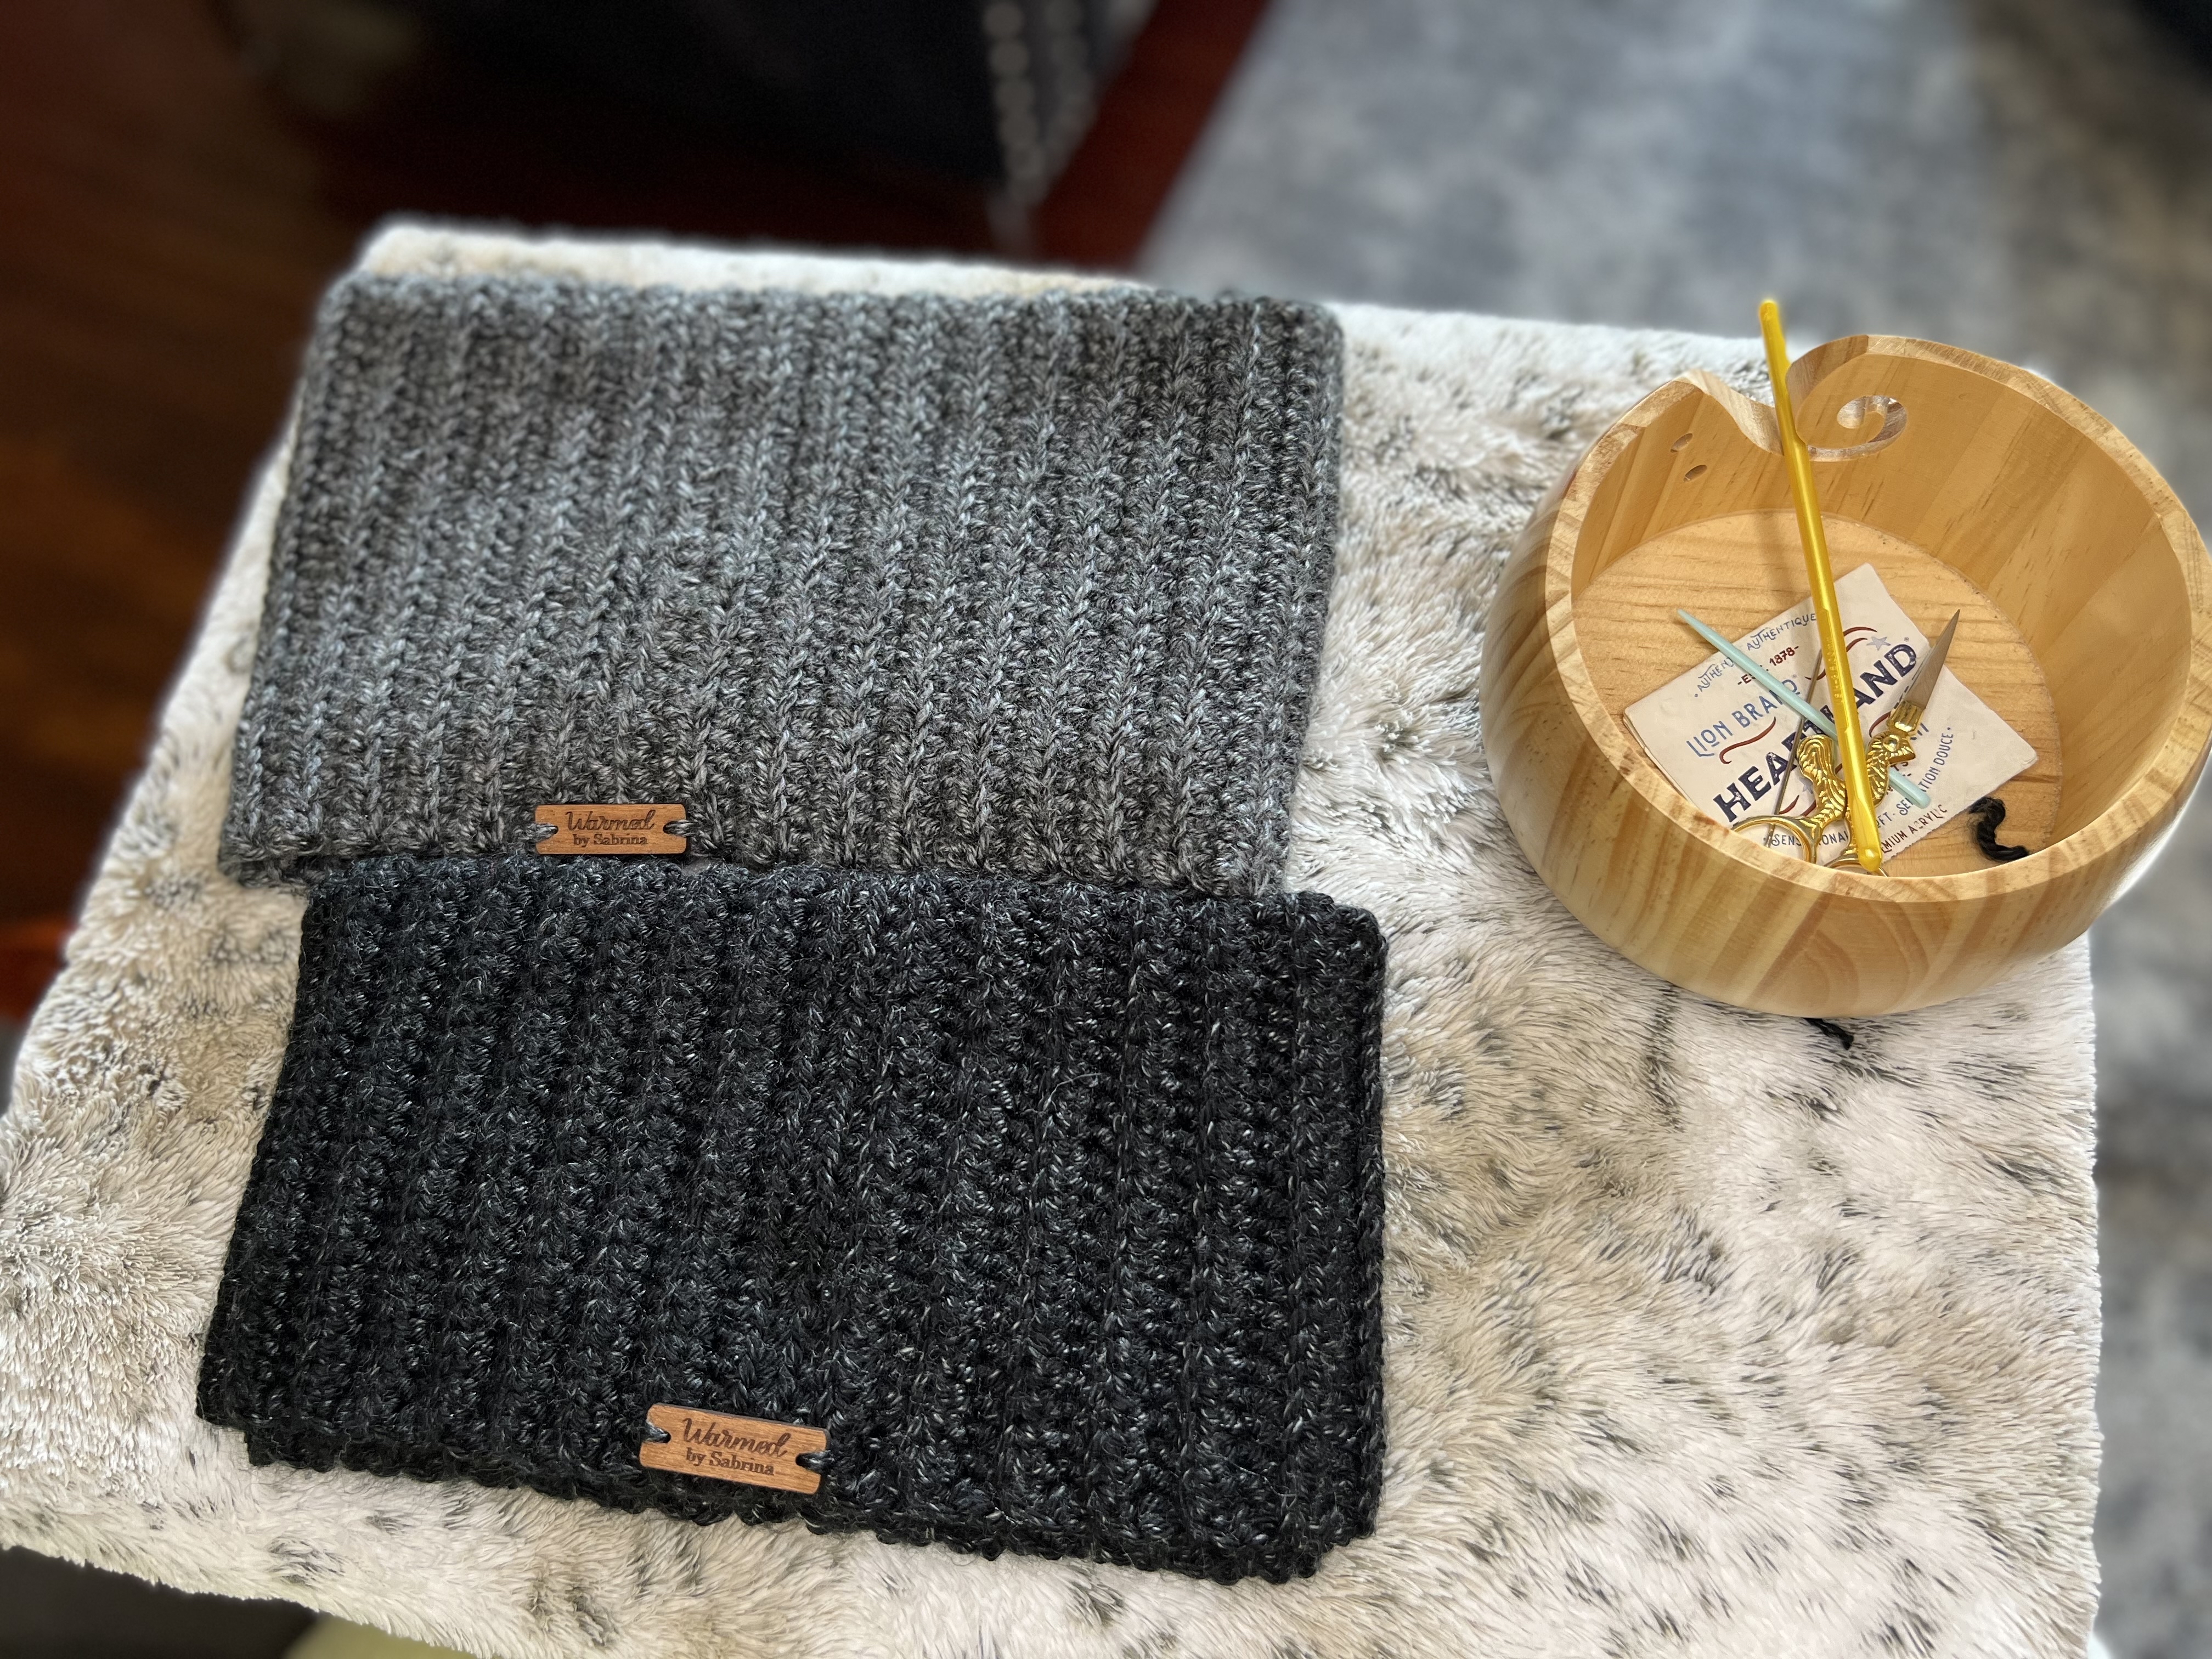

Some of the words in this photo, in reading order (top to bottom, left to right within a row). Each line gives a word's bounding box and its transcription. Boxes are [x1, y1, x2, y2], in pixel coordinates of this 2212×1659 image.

[1747, 613, 1817, 651] AUTHENTIQUE
[1686, 720, 1733, 757] LION
[1933, 733, 1954, 766] DOUCE
[565, 809, 656, 831] Warmed
[573, 833, 590, 848] by
[593, 833, 648, 845] Sabrina
[682, 1418, 792, 1458] Warmed
[686, 1447, 707, 1466] by
[709, 1451, 775, 1476] Sabrina
